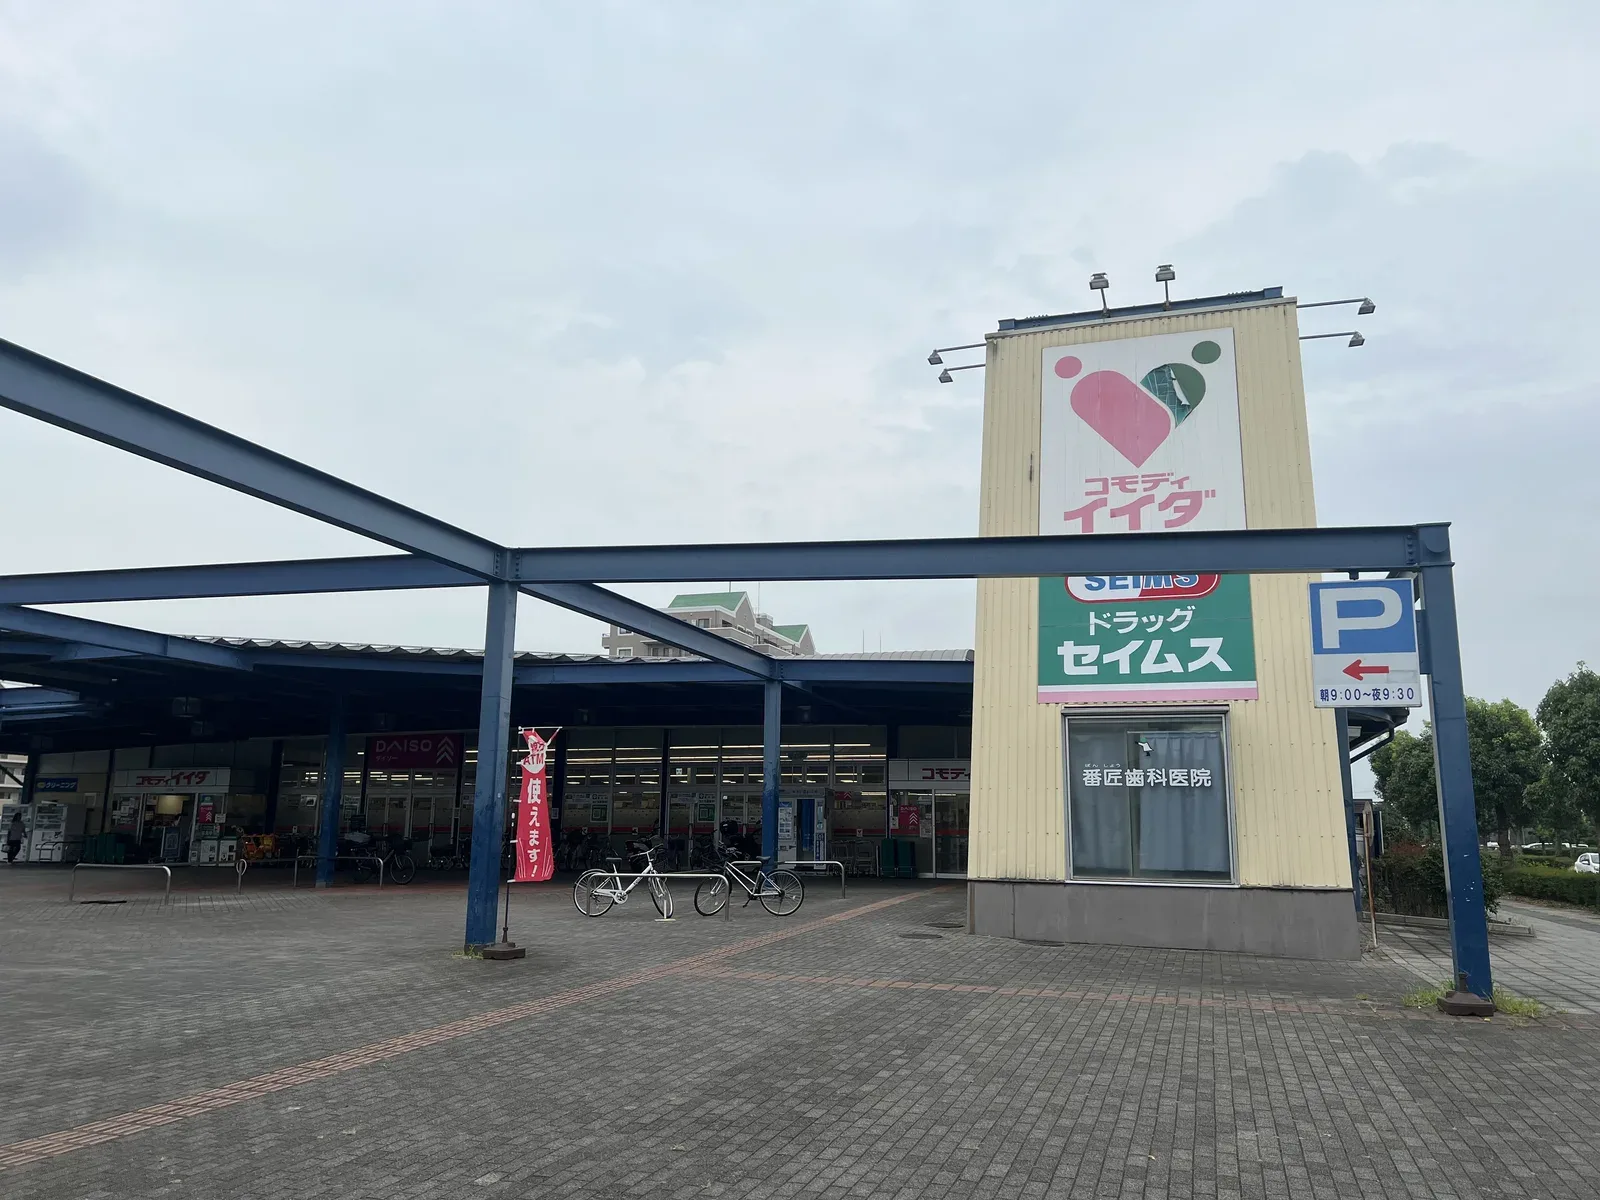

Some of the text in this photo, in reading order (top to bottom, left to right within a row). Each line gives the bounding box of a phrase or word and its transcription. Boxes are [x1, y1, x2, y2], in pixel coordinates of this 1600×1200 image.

[1085, 472, 1190, 496] コモディ
[1064, 489, 1216, 533] イイダ
[1089, 605, 1196, 636] ドラッグ
[1319, 586, 1402, 649] P
[1057, 637, 1233, 676] セイムス
[375, 739, 432, 752] DAISO
[45, 781, 77, 789] クリーニング
[1082, 768, 1212, 787] 番匠歯科医院
[527, 778, 542, 877] 使えます!
